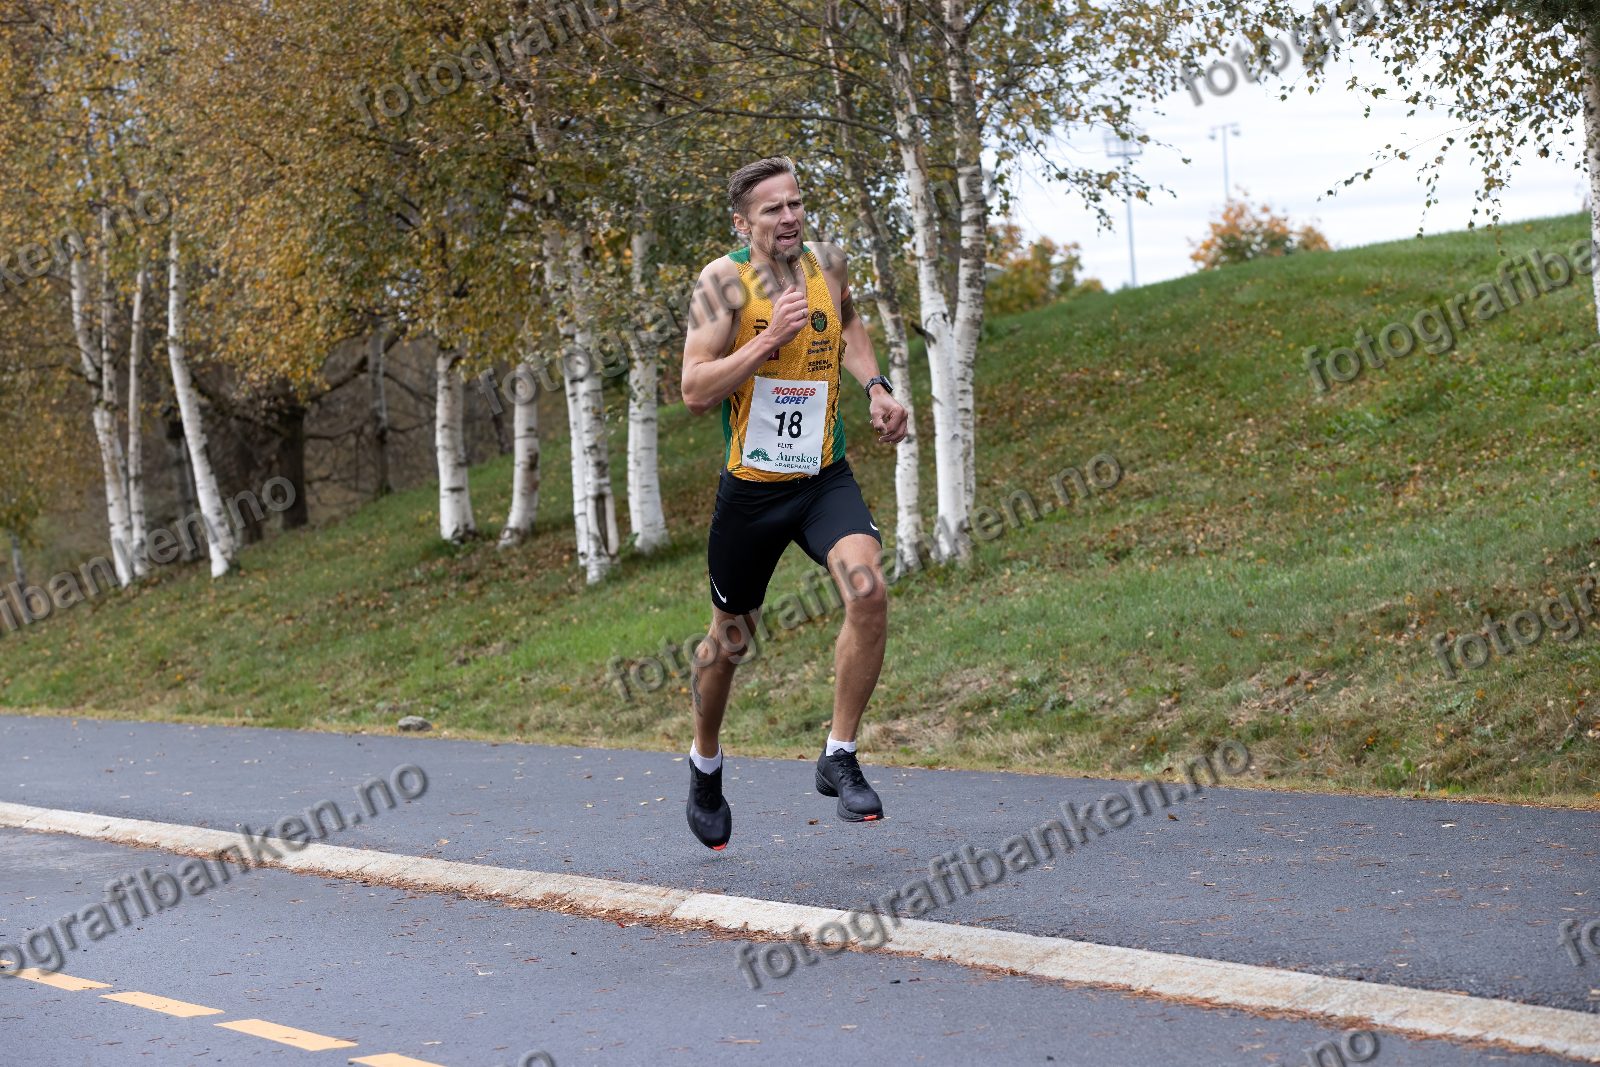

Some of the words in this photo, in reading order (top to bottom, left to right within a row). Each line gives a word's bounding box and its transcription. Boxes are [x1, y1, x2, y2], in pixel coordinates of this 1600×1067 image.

[771, 386, 817, 397] NORGES
[774, 395, 809, 405] LØPET
[774, 410, 803, 439] 18
[777, 442, 794, 450] ELITE
[776, 451, 819, 467] Aurskog
